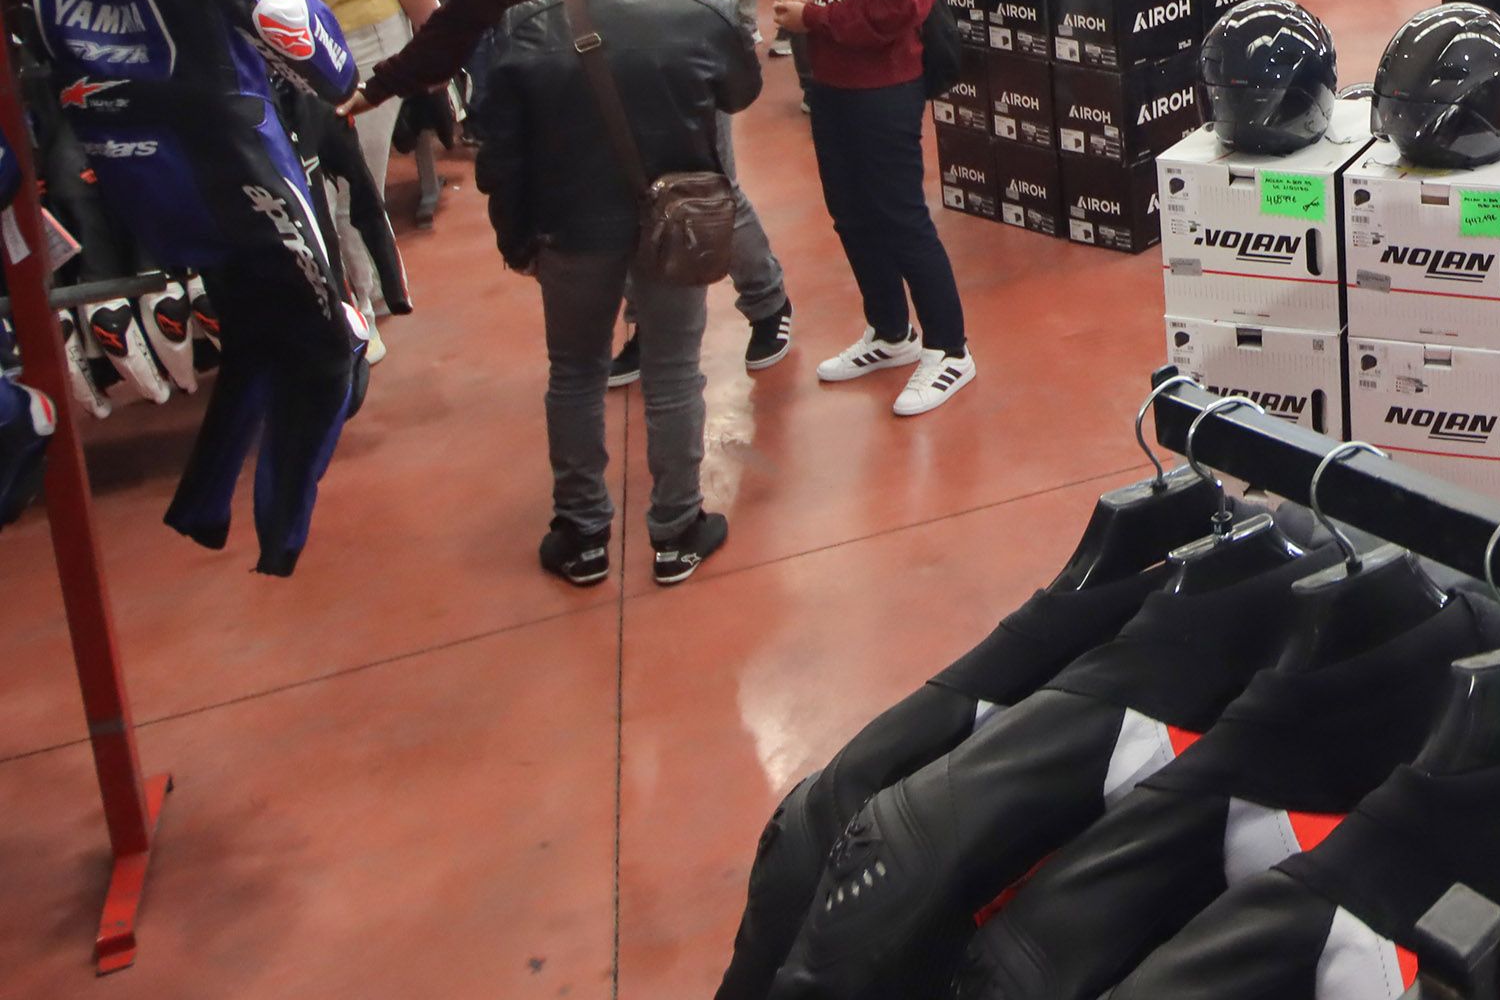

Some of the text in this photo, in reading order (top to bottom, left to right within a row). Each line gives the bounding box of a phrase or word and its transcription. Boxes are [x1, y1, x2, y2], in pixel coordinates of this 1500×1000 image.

[996, 1, 1037, 22] AIROH
[1063, 12, 1106, 33] AIROH
[1001, 90, 1039, 111] AIROH
[1136, 86, 1195, 126] AIROH
[1069, 104, 1112, 125] AIROH
[950, 164, 986, 184] AIROH
[1009, 178, 1047, 199] AIROH
[1077, 195, 1121, 216] AIROH
[1194, 228, 1302, 264] NOLAN
[1380, 246, 1496, 282] NOLAN
[1384, 406, 1497, 442] NOLAN
